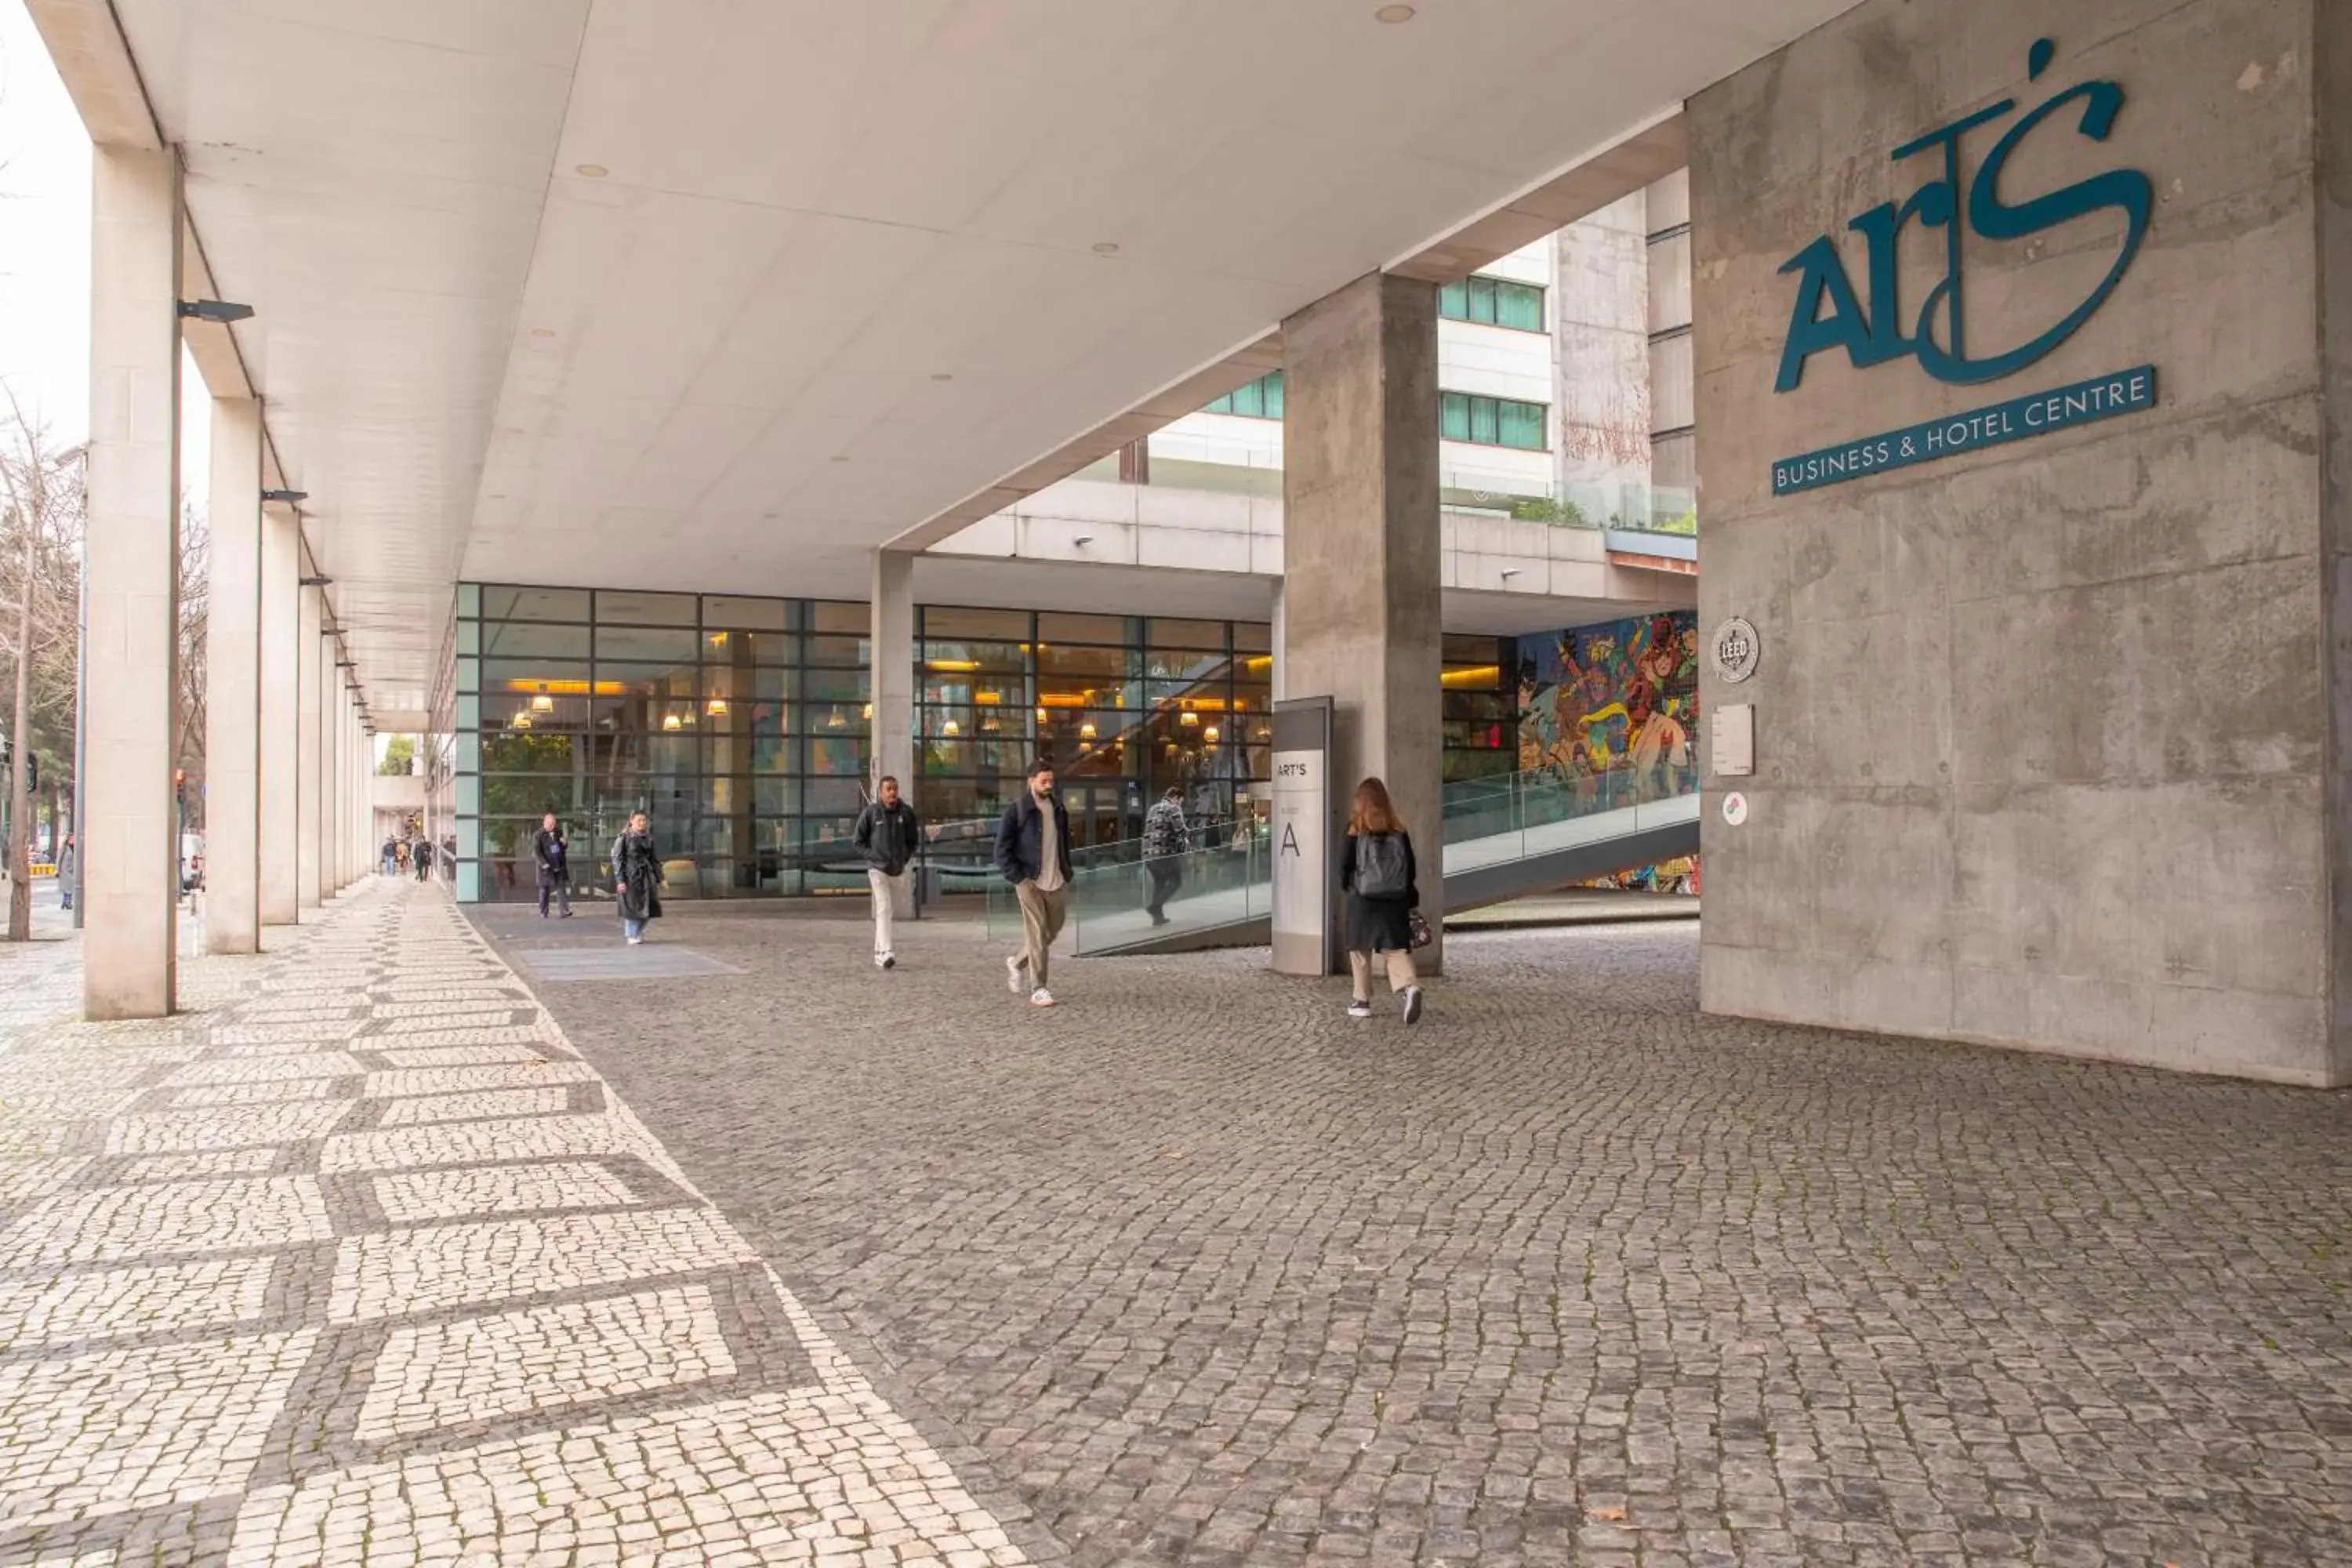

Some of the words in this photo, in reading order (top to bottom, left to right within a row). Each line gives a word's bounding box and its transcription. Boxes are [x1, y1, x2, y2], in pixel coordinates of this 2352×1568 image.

[1777, 441, 1889, 488] BUSINESS
[1900, 436, 1916, 457] &
[1927, 412, 2013, 451] HOTEL
[2025, 376, 2145, 426] CENTRE
[1722, 641, 1747, 658] LEED
[1278, 764, 1306, 776] ART'S
[1280, 822, 1301, 856] A
